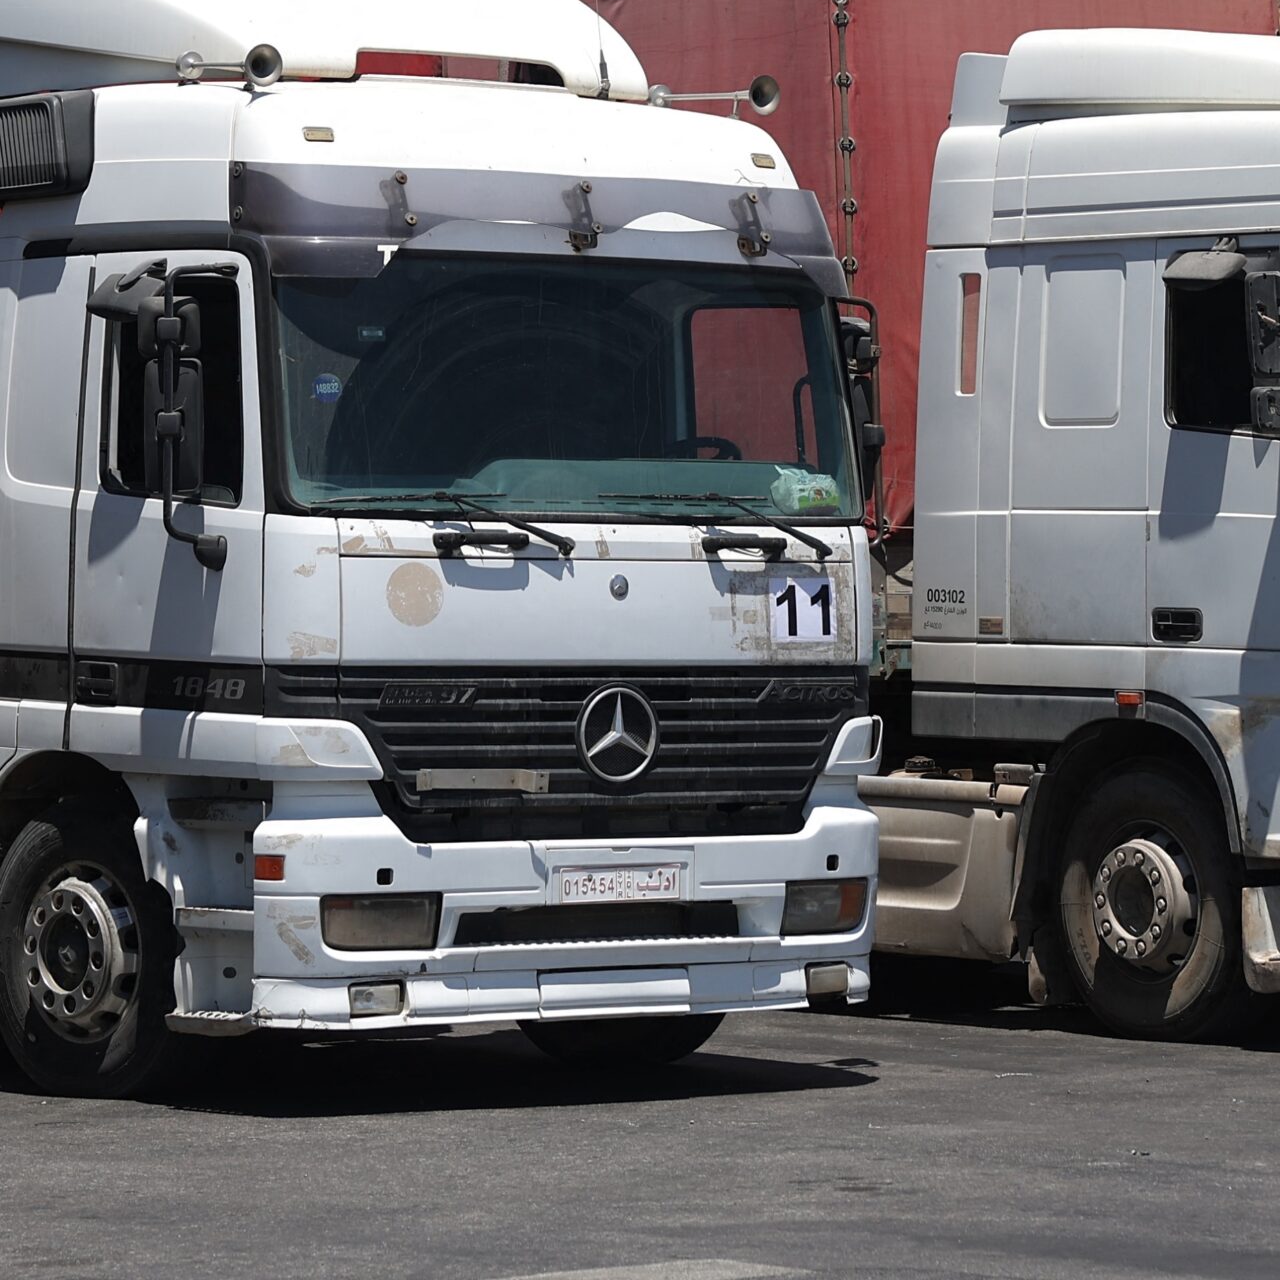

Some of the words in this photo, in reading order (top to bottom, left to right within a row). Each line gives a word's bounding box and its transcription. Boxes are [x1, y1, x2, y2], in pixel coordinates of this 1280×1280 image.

[926, 588, 965, 604] 003102
[776, 583, 834, 638] 11
[172, 675, 246, 700] 1848
[439, 686, 476, 704] 97
[563, 876, 615, 896] 015454
